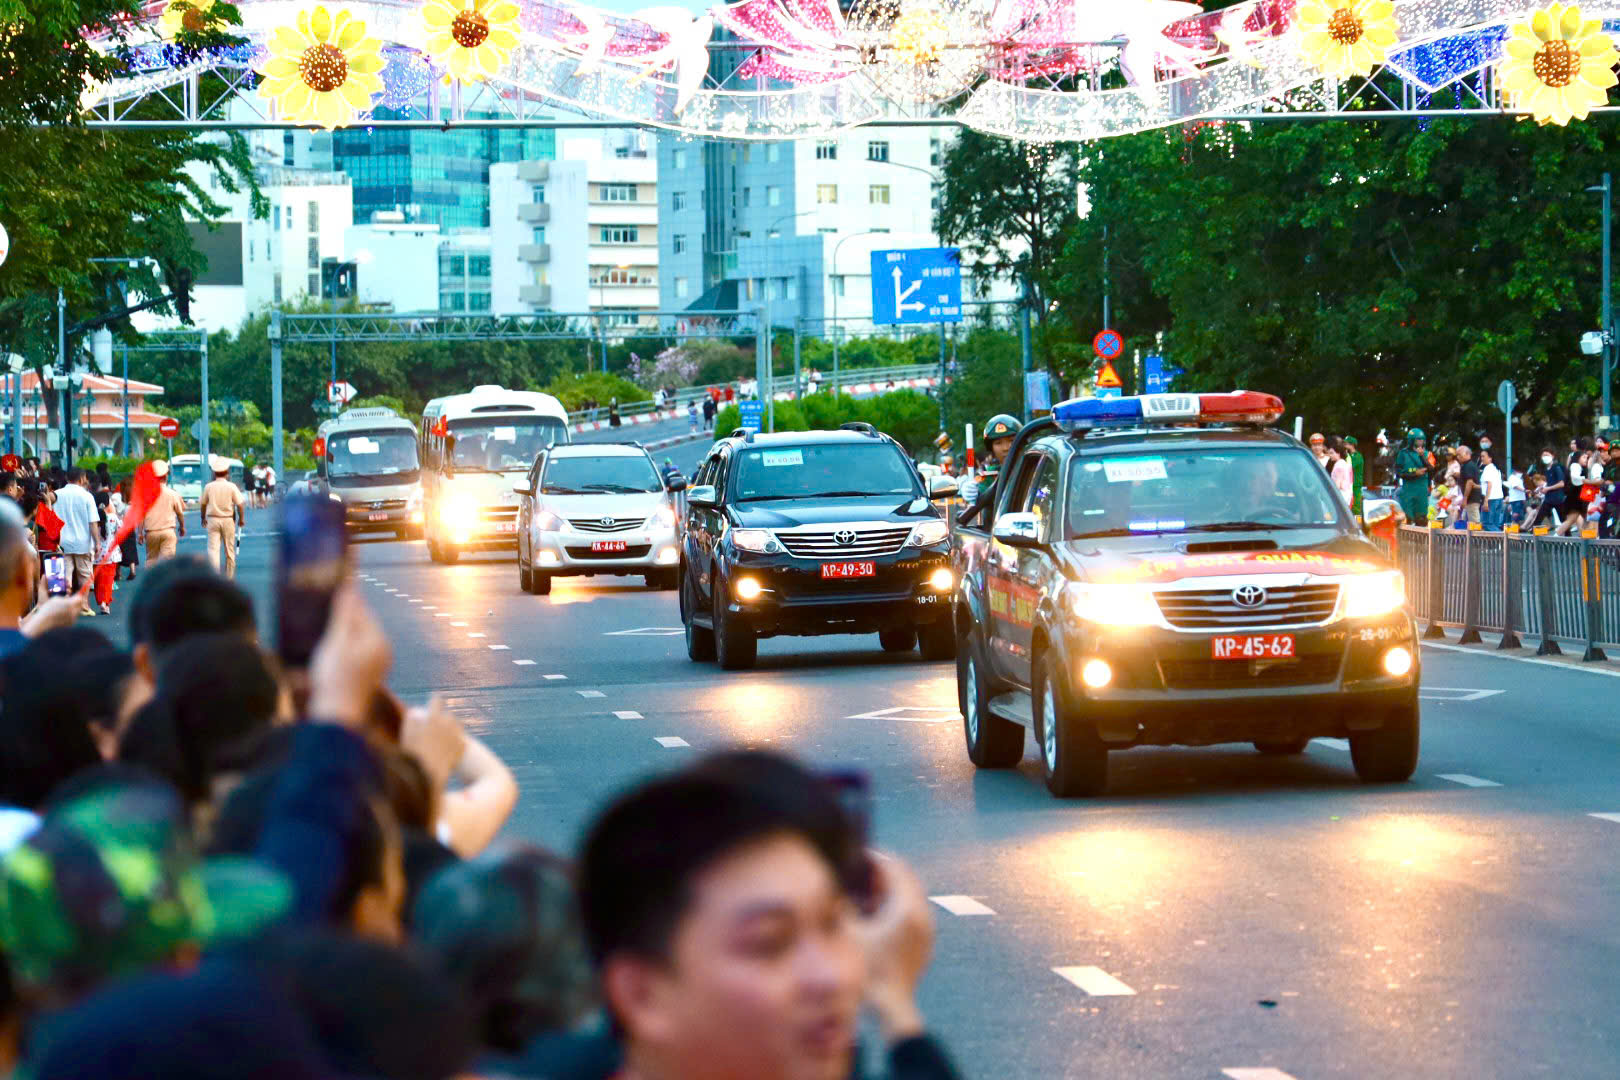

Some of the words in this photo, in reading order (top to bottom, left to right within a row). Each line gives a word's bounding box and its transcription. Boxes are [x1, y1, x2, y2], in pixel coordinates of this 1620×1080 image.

[822, 562, 873, 577] KP-49-30
[917, 594, 937, 604] 18-01
[1214, 636, 1293, 657] KP-45-62
